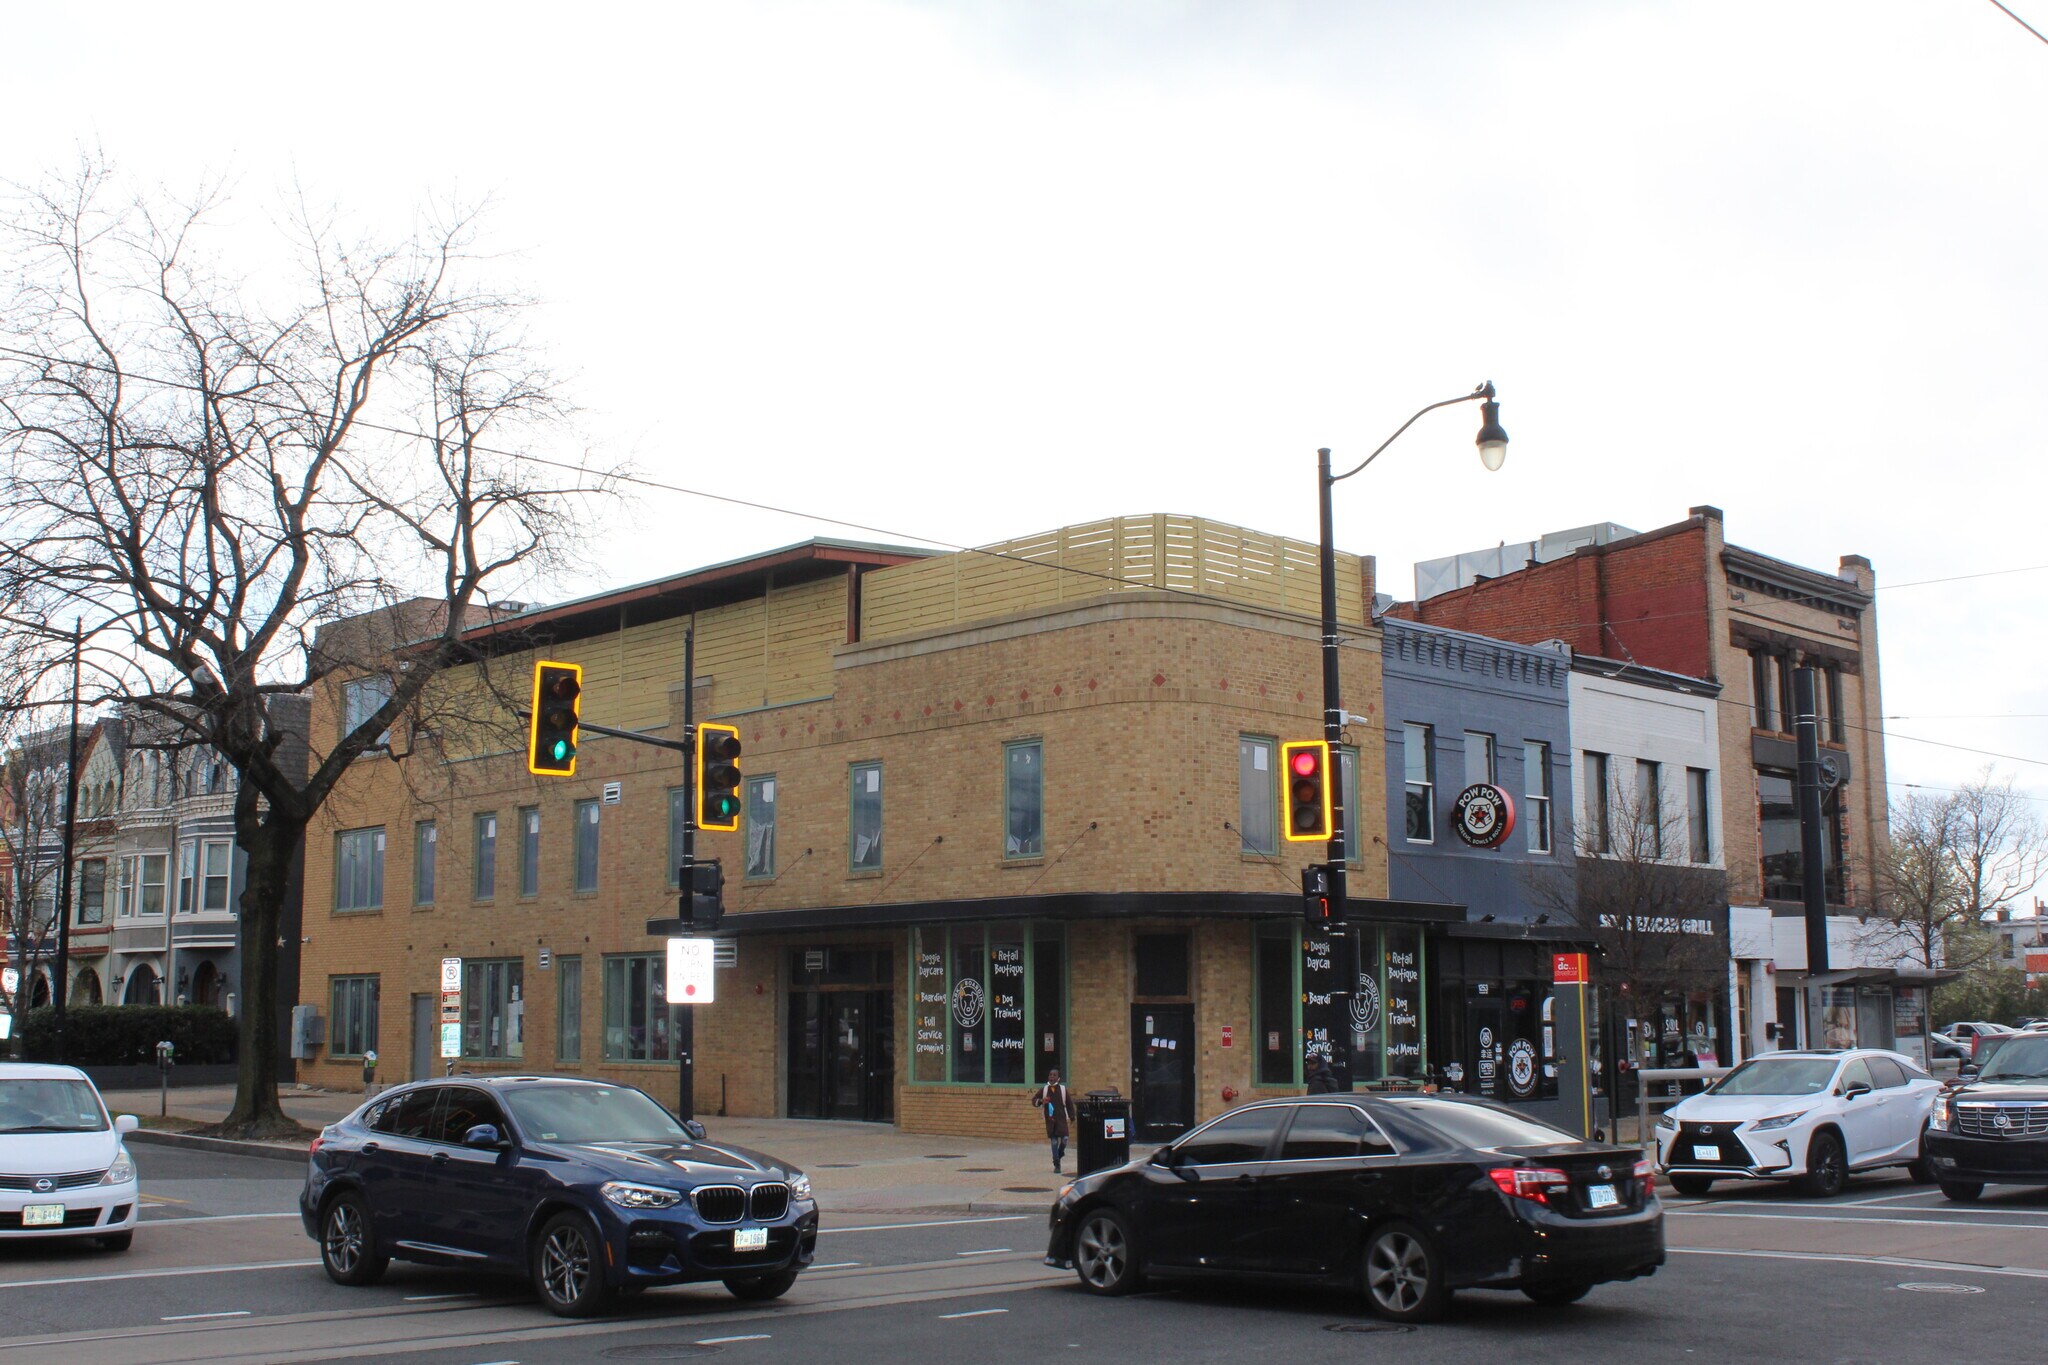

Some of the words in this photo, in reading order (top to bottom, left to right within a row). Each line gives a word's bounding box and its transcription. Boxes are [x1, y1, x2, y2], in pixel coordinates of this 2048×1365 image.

[1458, 787, 1478, 808] POW
[1481, 787, 1502, 806] POW
[1681, 918, 1714, 935] GRILL
[682, 944, 700, 956] NO
[998, 950, 1018, 962] Retail
[922, 954, 940, 964] Doggie
[1392, 952, 1412, 967] Retail
[920, 966, 943, 977] Daycare
[994, 964, 1023, 976] Boutique
[1388, 967, 1417, 982] Boutique
[921, 992, 947, 1004] Boarding
[1002, 994, 1013, 1006] Dog
[1309, 992, 1330, 1005] Boardi
[1396, 998, 1407, 1012] Dog
[994, 1007, 1022, 1020] Training
[924, 1017, 935, 1026] Full
[1388, 1013, 1416, 1027] Training
[1666, 1019, 1680, 1030] SOL
[918, 1030, 942, 1040] Service
[1314, 1028, 1327, 1041] Full
[916, 1043, 944, 1054] Grooming
[992, 1039, 1004, 1049] and
[1005, 1038, 1024, 1049] More!
[1387, 1043, 1399, 1054] and
[1400, 1043, 1419, 1054] More!
[1509, 1041, 1521, 1058] POW
[1522, 1041, 1535, 1058] POW
